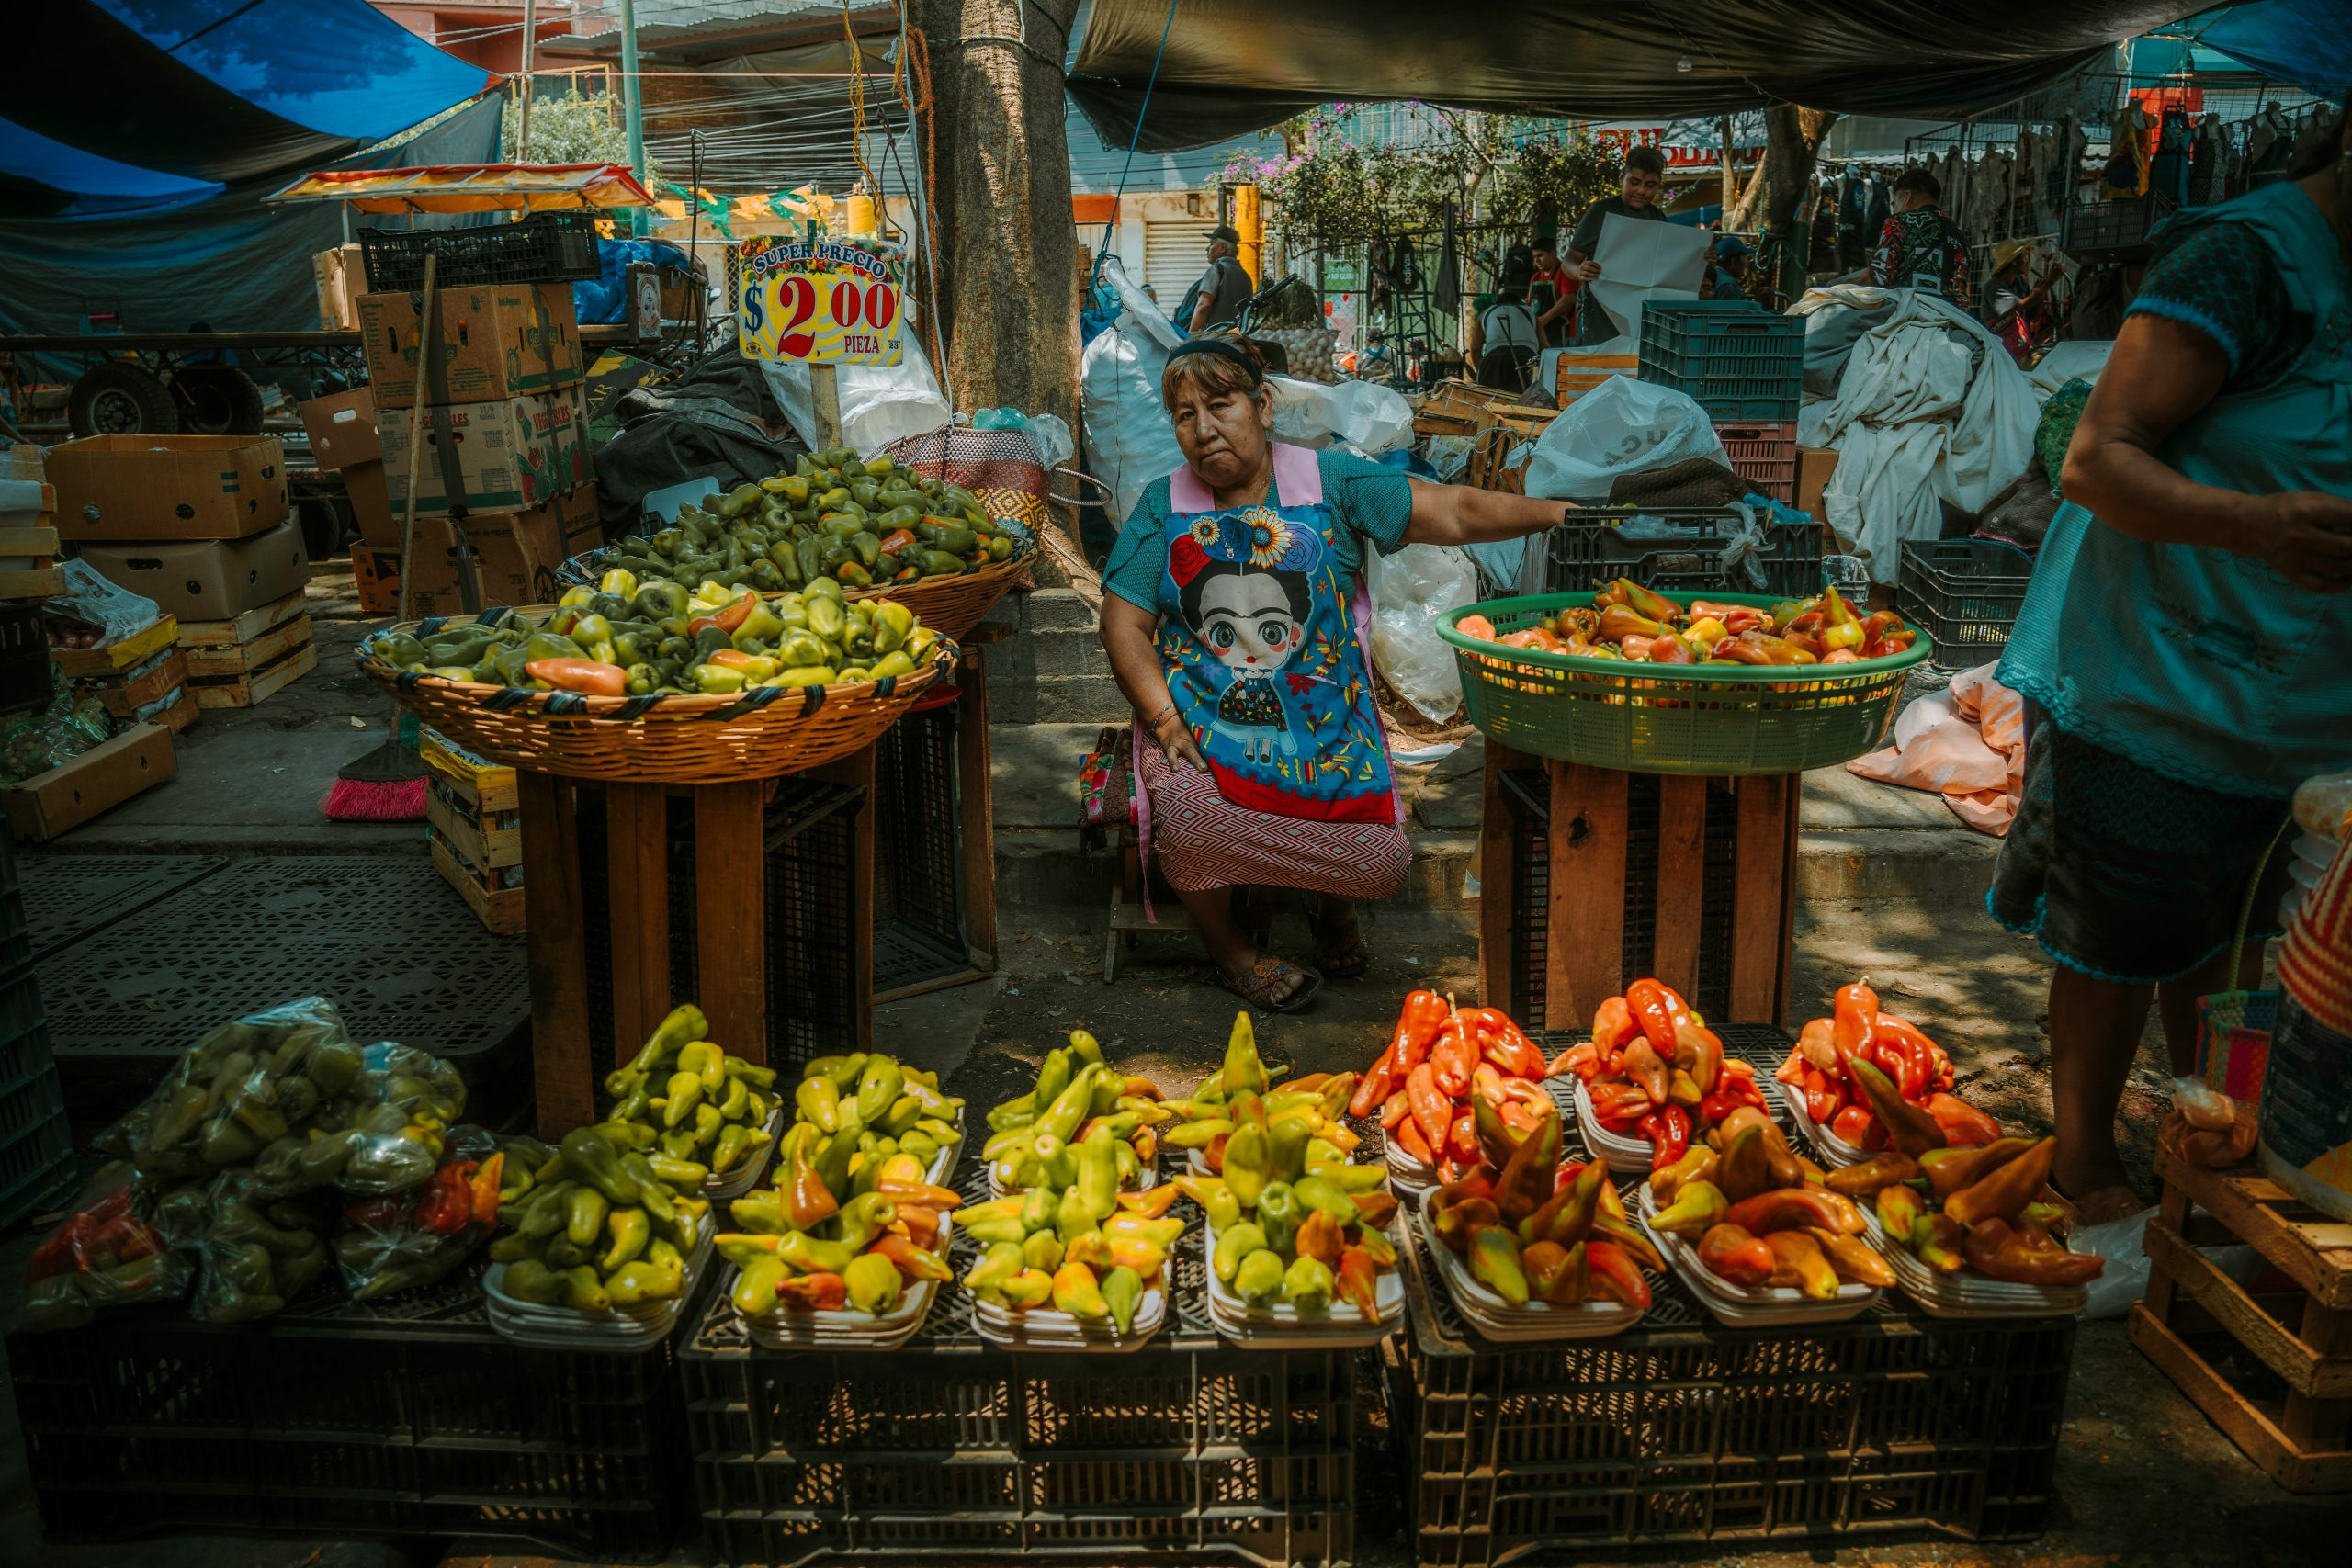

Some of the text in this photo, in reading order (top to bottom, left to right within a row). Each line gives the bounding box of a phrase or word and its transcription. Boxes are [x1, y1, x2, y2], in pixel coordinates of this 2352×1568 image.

[754, 243, 886, 277] SUPER PRECIO
[1403, 253, 1412, 285] adidas
[843, 335, 880, 354] PIEZA
